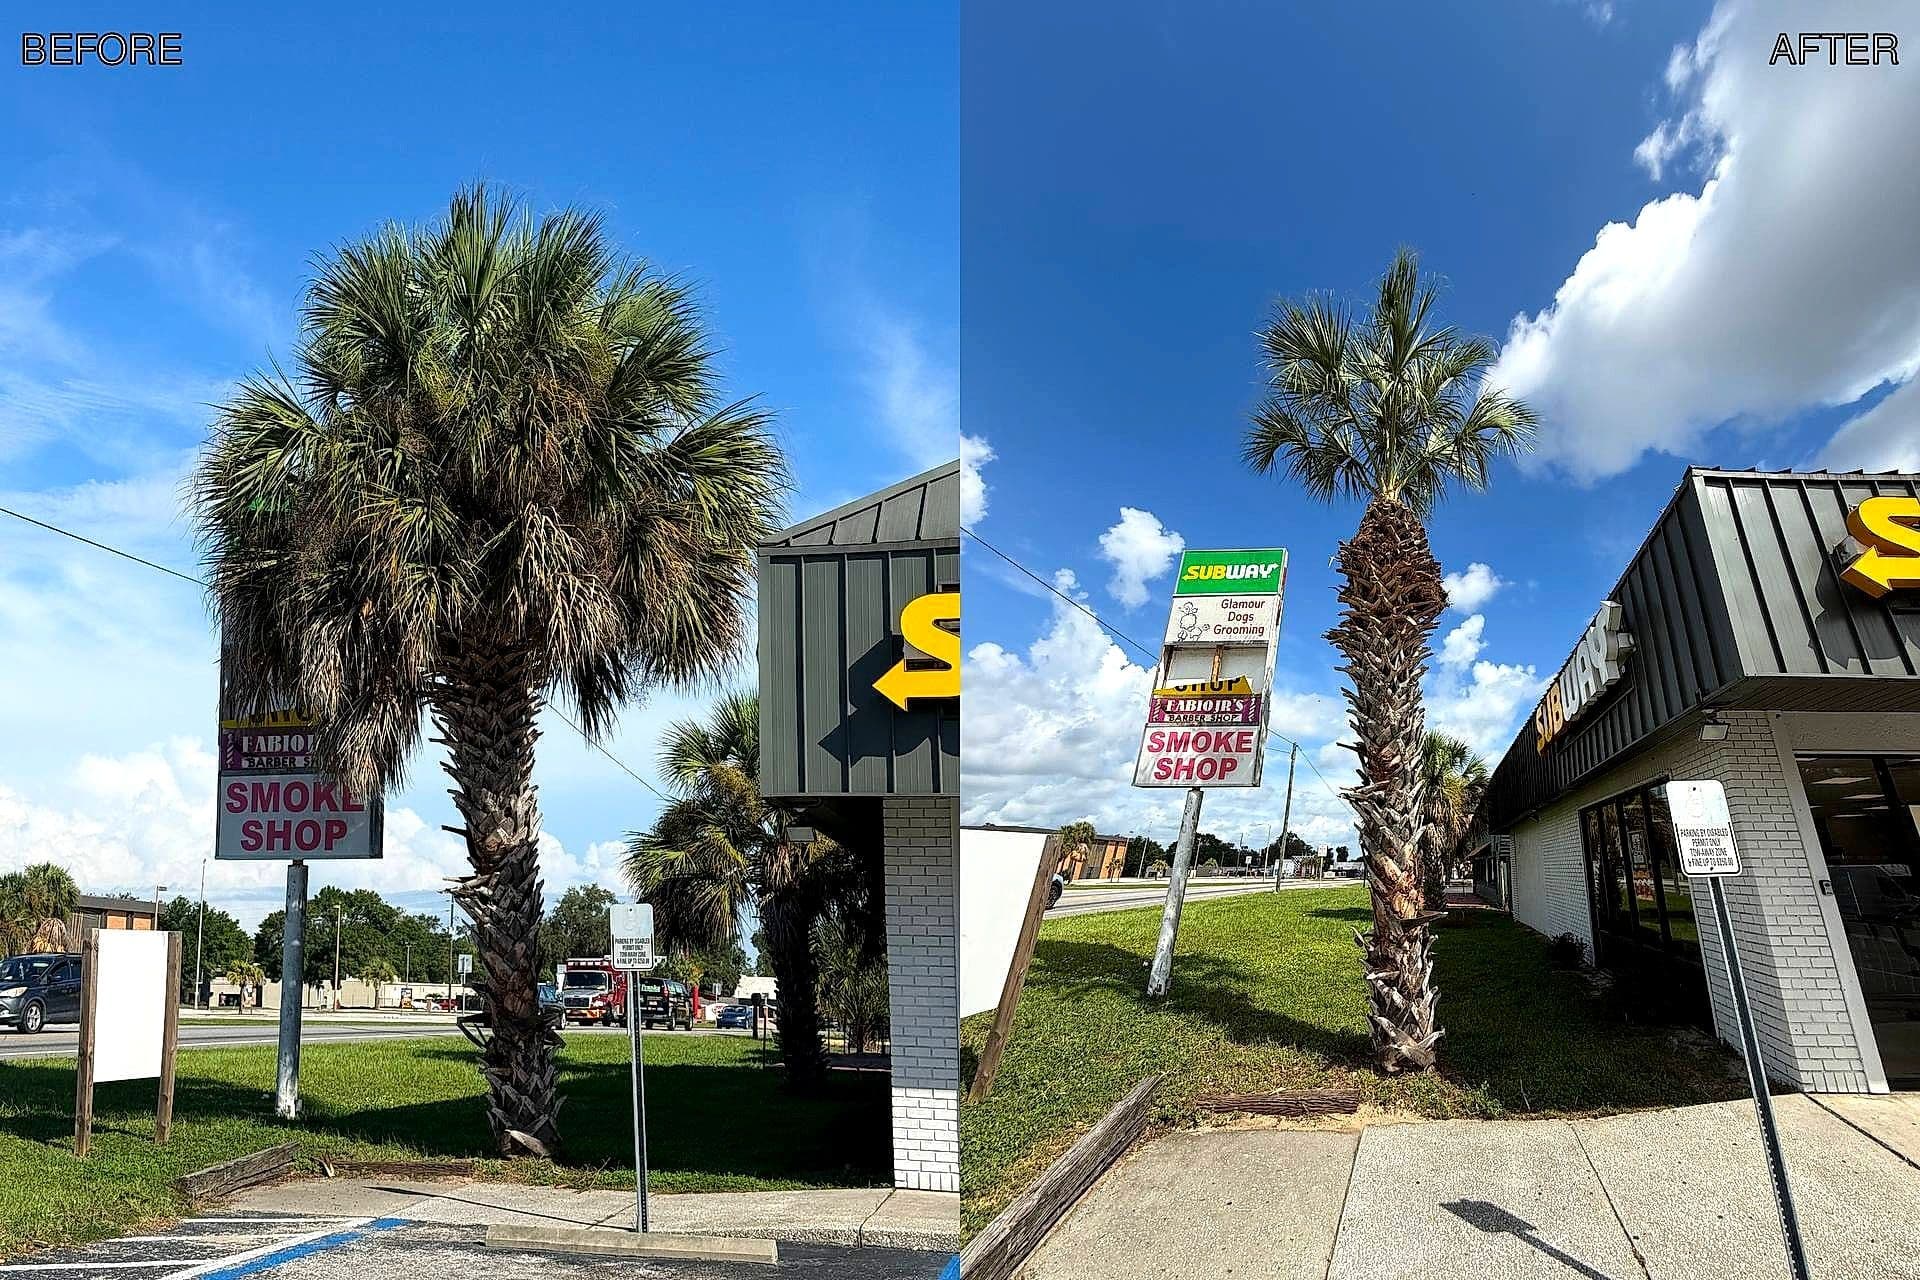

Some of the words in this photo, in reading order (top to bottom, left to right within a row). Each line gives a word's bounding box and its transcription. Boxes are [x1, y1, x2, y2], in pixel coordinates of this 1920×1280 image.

[1182, 563, 1279, 581] SUBWAY
[1221, 599, 1265, 609] Glamour
[1228, 612, 1254, 624] Dogs
[1214, 624, 1265, 636] Grooming
[1536, 600, 1637, 758] SUBWAY
[1169, 714, 1205, 722] BARBER
[1210, 714, 1238, 722] SHOP
[1147, 731, 1254, 753] SMOKE
[248, 757, 296, 768] BARBER
[1154, 757, 1238, 780] SHOP
[240, 820, 348, 852] SHOP
[1680, 829, 1700, 837] PARKING
[1707, 828, 1728, 837] DISABLED
[1692, 838, 1709, 847] PERMIT
[1709, 838, 1721, 846] ONLY
